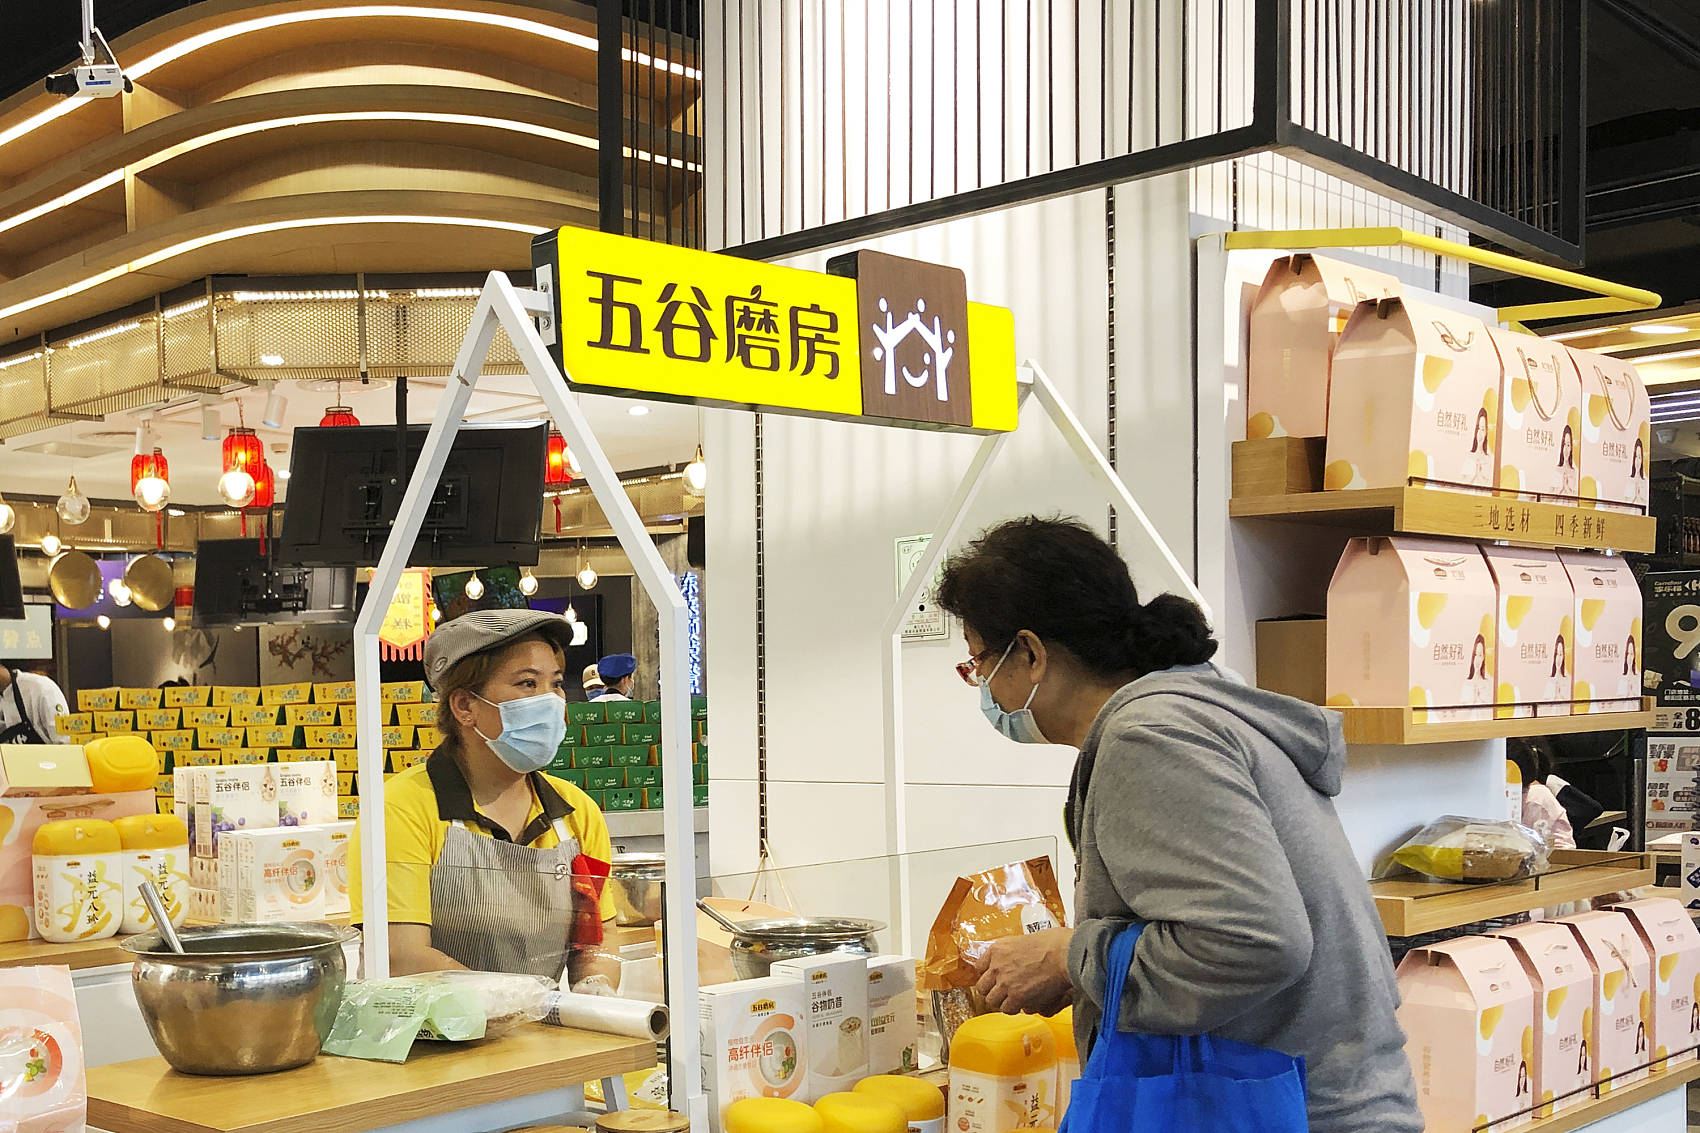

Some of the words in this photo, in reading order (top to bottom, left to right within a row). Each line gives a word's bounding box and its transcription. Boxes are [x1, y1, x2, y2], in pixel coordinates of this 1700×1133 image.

[586, 270, 841, 380] 五谷磨房
[1437, 409, 1468, 431] 自然好礼
[1527, 427, 1555, 447] 自然好礼
[1602, 440, 1628, 459] 自然好礼
[1472, 503, 1531, 533] 三地选材
[1554, 513, 1606, 541] 四季新鲜
[1433, 642, 1464, 660] 自然好礼
[1520, 642, 1548, 659] 自然好礼
[1595, 642, 1620, 659] 自然好礼
[215, 781, 250, 793] 五谷伴侣
[280, 777, 311, 787] 五谷伴侣
[811, 996, 843, 1013] 谷物奶昔
[728, 1041, 774, 1063] 高纤伴侣
